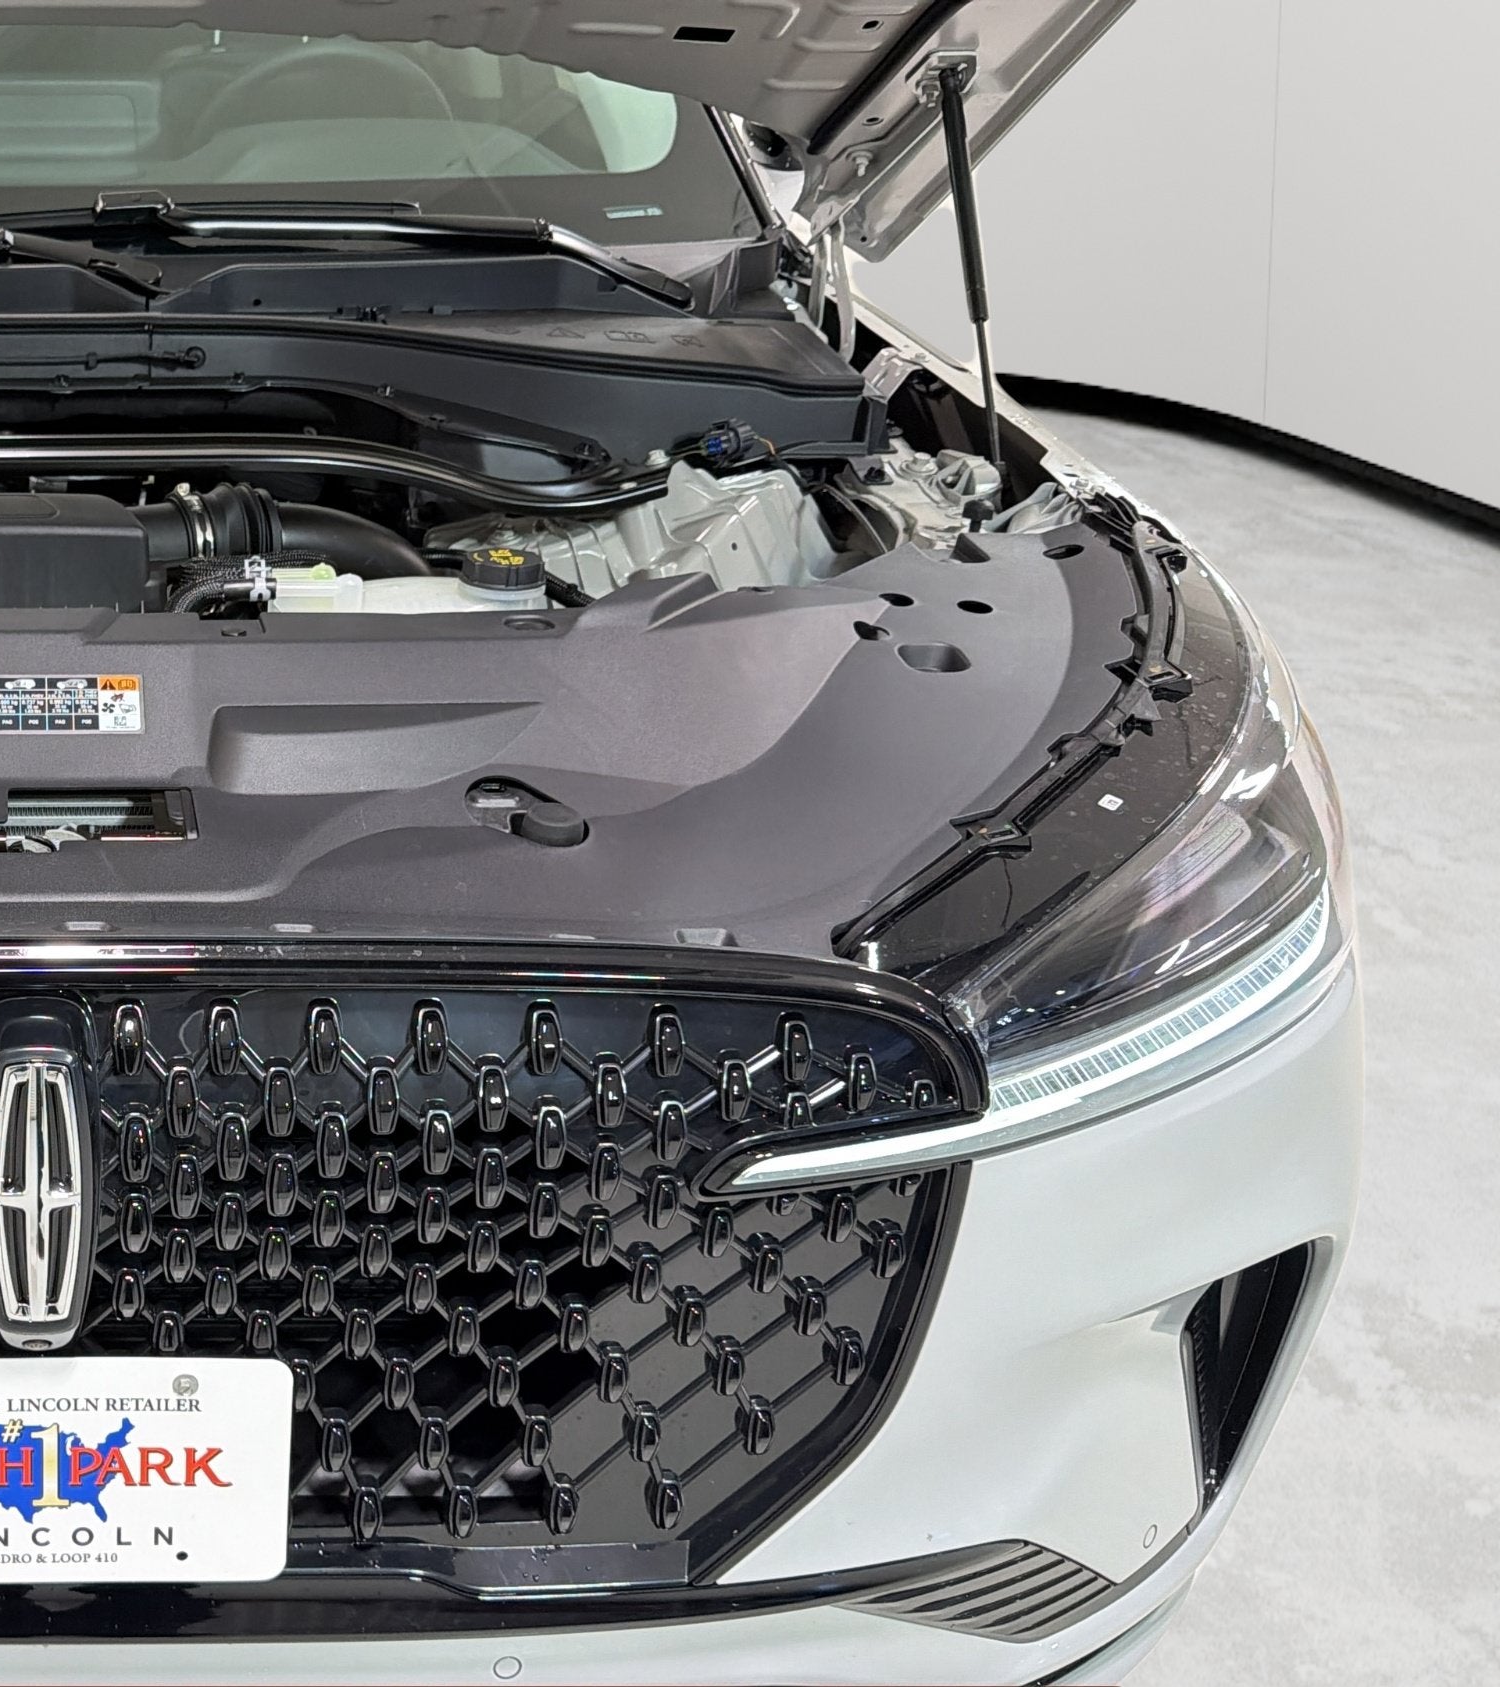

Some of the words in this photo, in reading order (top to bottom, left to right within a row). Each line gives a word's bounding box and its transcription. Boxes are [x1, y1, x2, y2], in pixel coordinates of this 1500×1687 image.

[7, 1398, 101, 1413] LINCOLN
[105, 1397, 202, 1412] RETAILER
[69, 1446, 233, 1487] PARK
[36, 1553, 47, 1564] &
[51, 1553, 91, 1564] LOOP
[95, 1552, 119, 1564] 410
